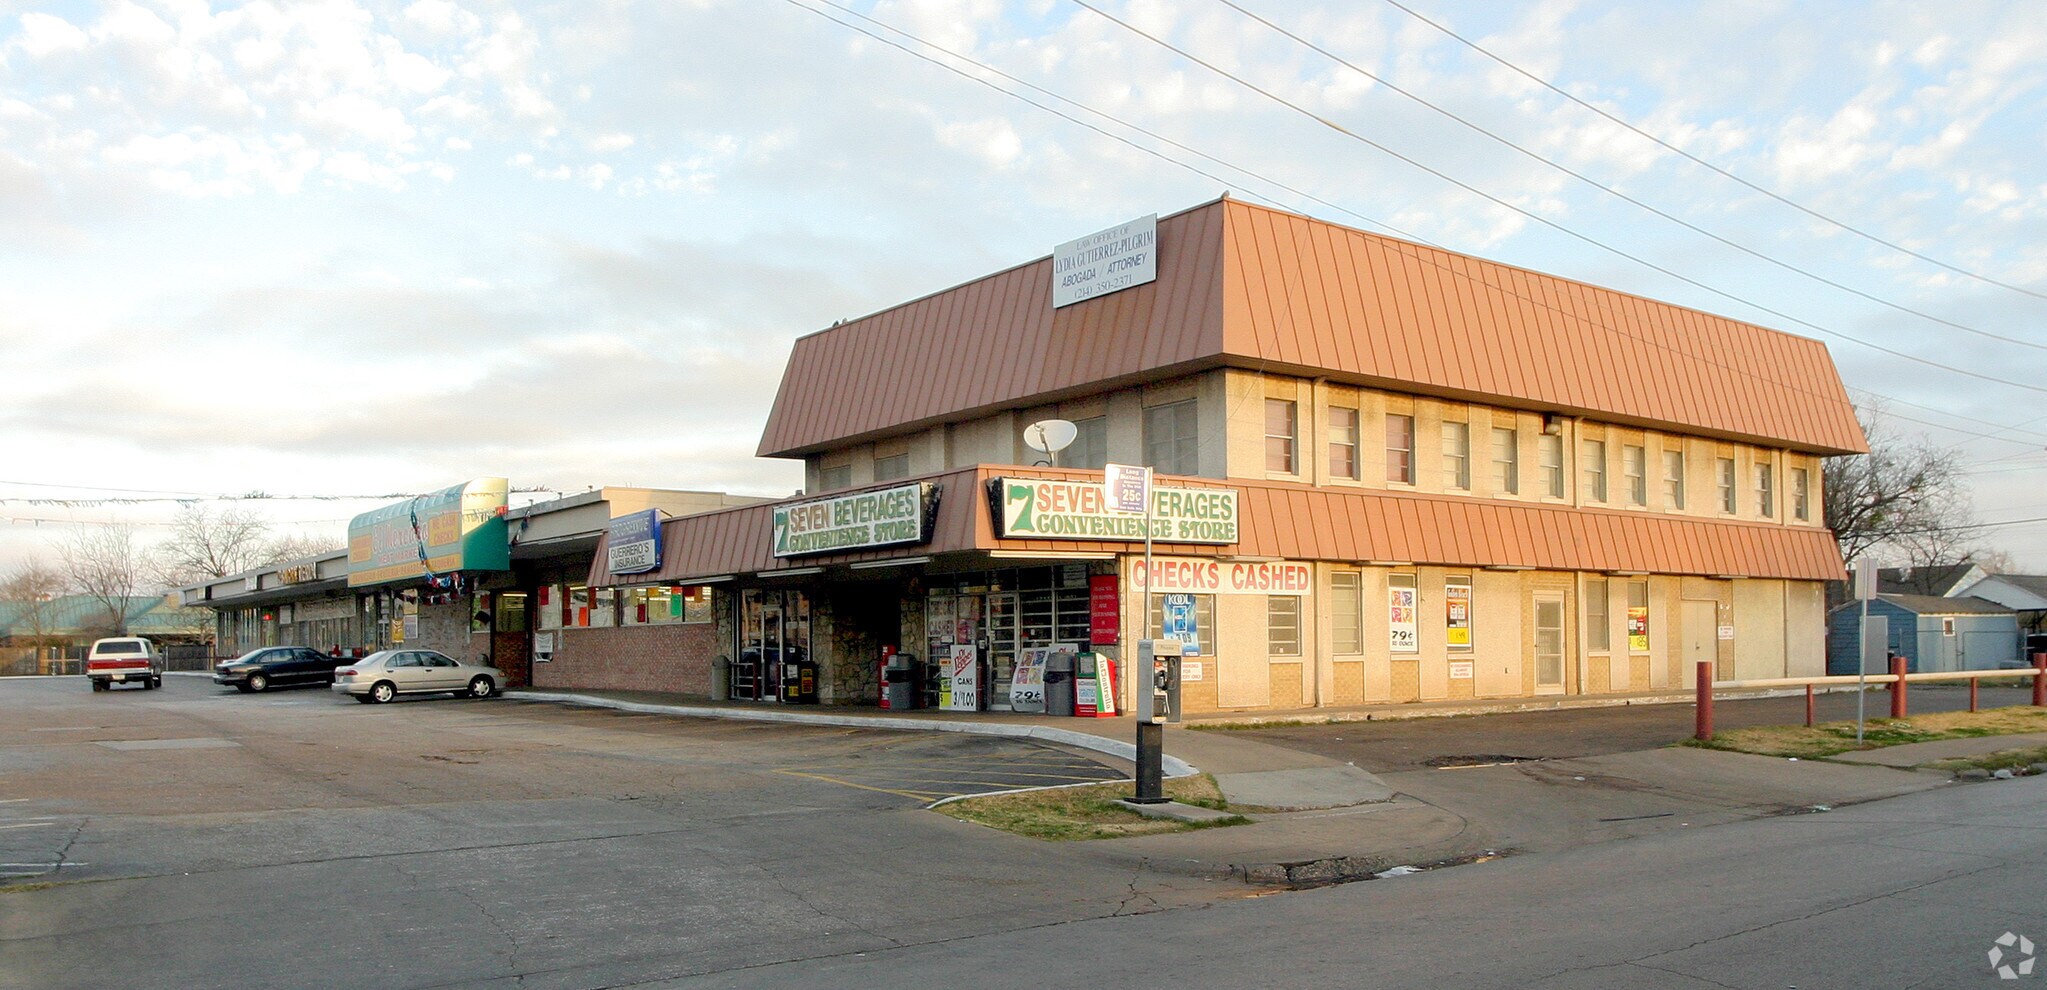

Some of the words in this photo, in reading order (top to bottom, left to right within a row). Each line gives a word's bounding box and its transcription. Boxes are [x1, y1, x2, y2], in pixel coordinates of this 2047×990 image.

[1076, 239, 1090, 250] LAW
[1093, 230, 1118, 245] OFFICE
[1120, 225, 1130, 235] OF
[1055, 256, 1076, 274] LYDIA
[1077, 230, 1154, 268] GUTIERREZ-PILGRIM
[1062, 268, 1097, 288] ABOGADA
[1107, 252, 1148, 275] ATTORNEY
[775, 510, 790, 553] 7
[790, 502, 829, 533] SEVEN
[834, 487, 915, 526] BEVERAGES
[1007, 484, 1035, 533] 7
[1036, 483, 1110, 514] SEVEN
[1117, 489, 1233, 520] VERAGES
[789, 525, 870, 552] CONVENIENCE
[874, 518, 917, 544] STORE
[1036, 514, 1172, 538] CONVENIENCE
[1178, 520, 1235, 541] STORE
[610, 542, 650, 559] GUERRERO'S
[615, 554, 645, 568] INSURANCE
[1132, 560, 1220, 589] CHECKS
[1231, 563, 1309, 592] CASHED
[1168, 594, 1191, 605] KOOL
[1392, 630, 1413, 640] 79¢
[957, 677, 973, 685] CANS
